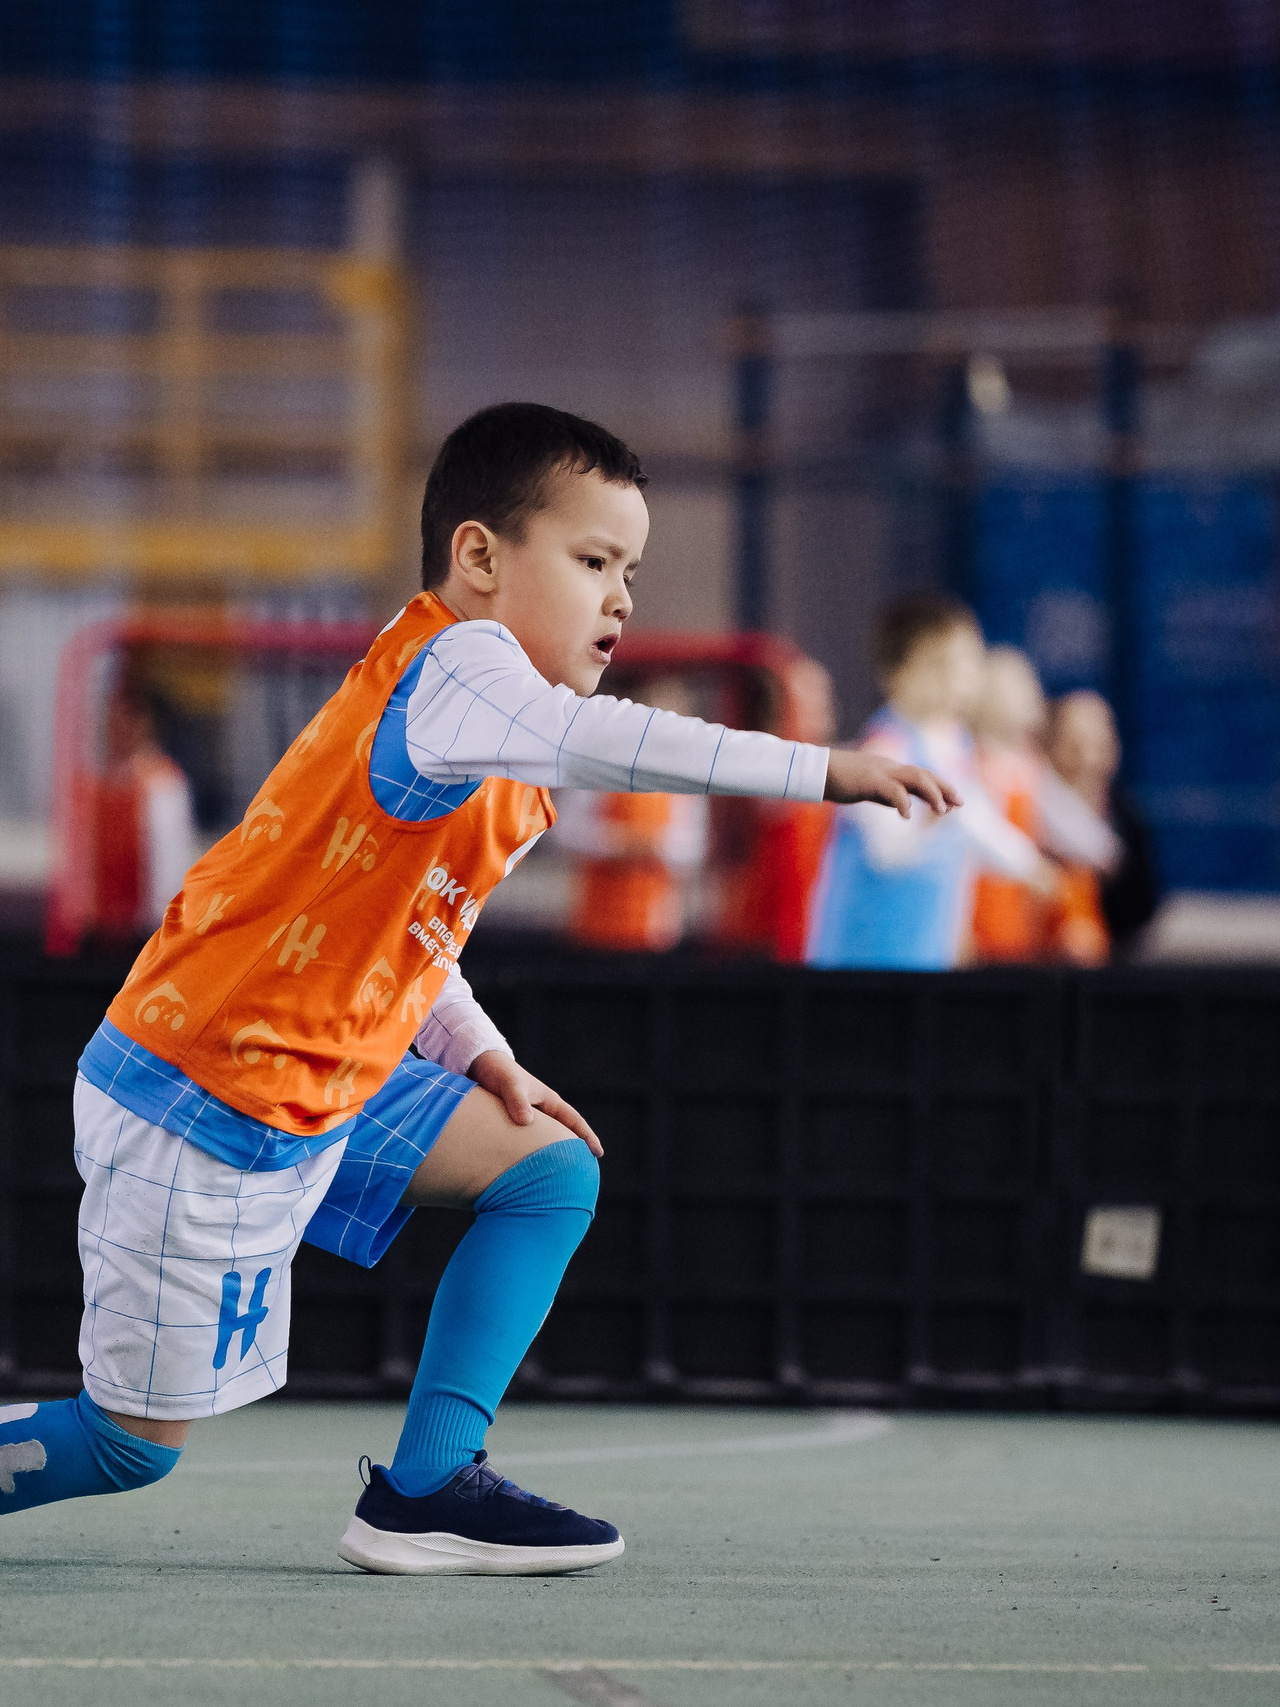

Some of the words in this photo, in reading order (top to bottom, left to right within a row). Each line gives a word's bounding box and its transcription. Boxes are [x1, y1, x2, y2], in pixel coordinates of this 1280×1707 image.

[426, 867, 467, 906] ФК
[407, 920, 444, 960] ВМЕСТ
[212, 1267, 272, 1370] H
